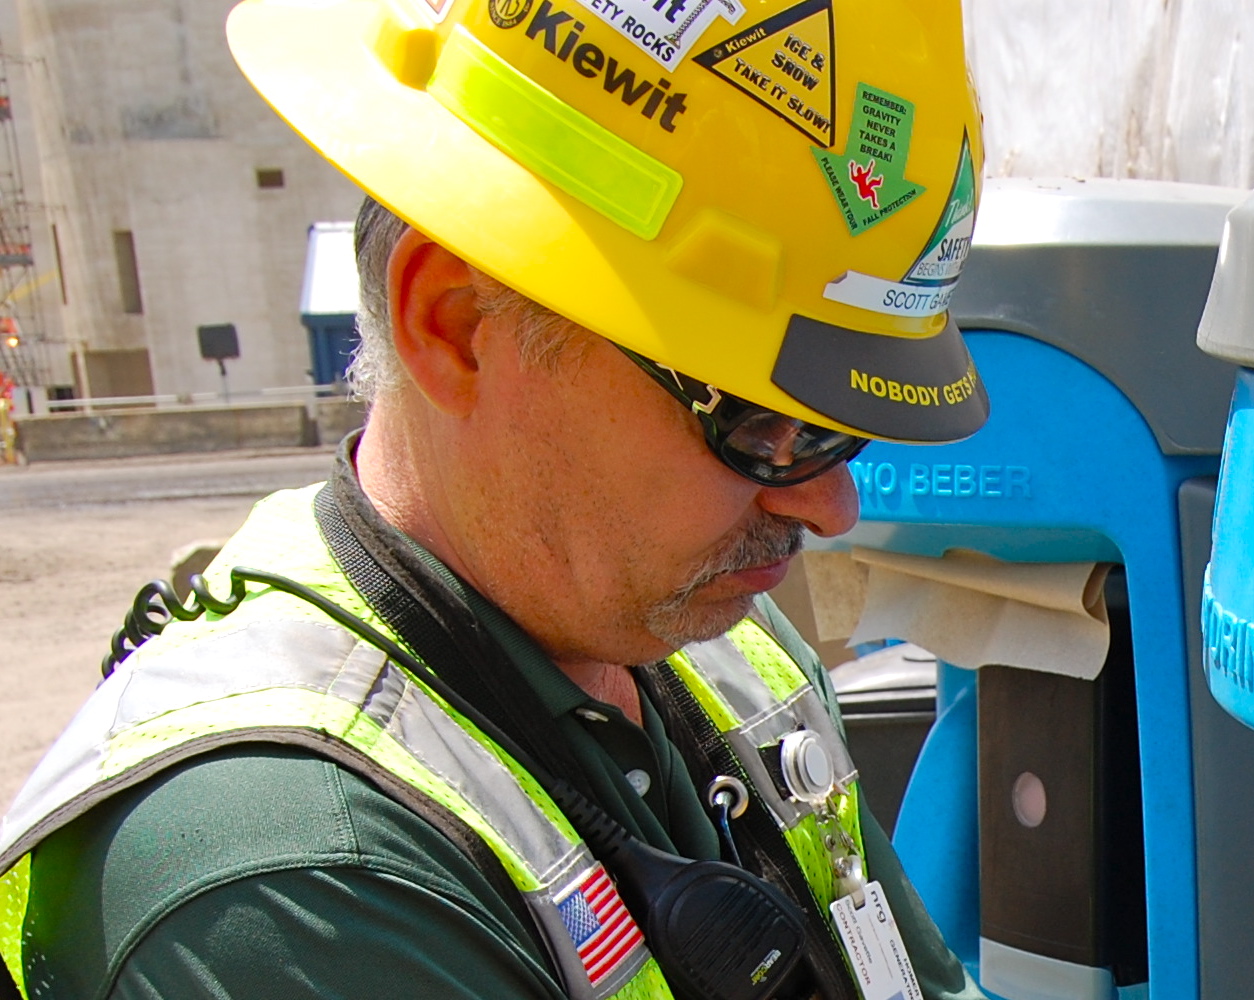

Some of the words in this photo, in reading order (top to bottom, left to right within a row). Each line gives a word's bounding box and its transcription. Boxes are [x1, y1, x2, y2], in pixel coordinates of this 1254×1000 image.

[590, 0, 624, 21] ETY
[621, 15, 675, 62] ROCKS
[725, 27, 767, 53] Kiewit
[525, 0, 688, 134] Kiewit
[771, 50, 819, 91] SNOW
[784, 33, 812, 61] ICE
[810, 52, 825, 73] &
[733, 57, 772, 91] TAKE
[770, 83, 787, 100] IT
[786, 95, 831, 134] SLOW!
[862, 90, 907, 115] REMEMBER:
[862, 105, 901, 126] GRAVITY
[866, 119, 896, 138] NEVER
[859, 130, 888, 147] TAKES
[890, 141, 896, 151] A
[860, 143, 893, 163] BREAK!
[821, 157, 837, 187] PLEASE
[835, 186, 849, 209] WEAR
[845, 208, 858, 230] YOUR
[862, 214, 880, 227] FALL
[880, 188, 917, 217] PROTECTION
[883, 289, 931, 311] SCOTT
[850, 369, 940, 406] NOBODY
[943, 376, 972, 405] GETS
[854, 461, 897, 495] NO
[909, 462, 1031, 499] BEBER
[870, 890, 887, 924] nrg
[836, 903, 871, 986] CONTRACTOR
[903, 957, 920, 997] HOMER
